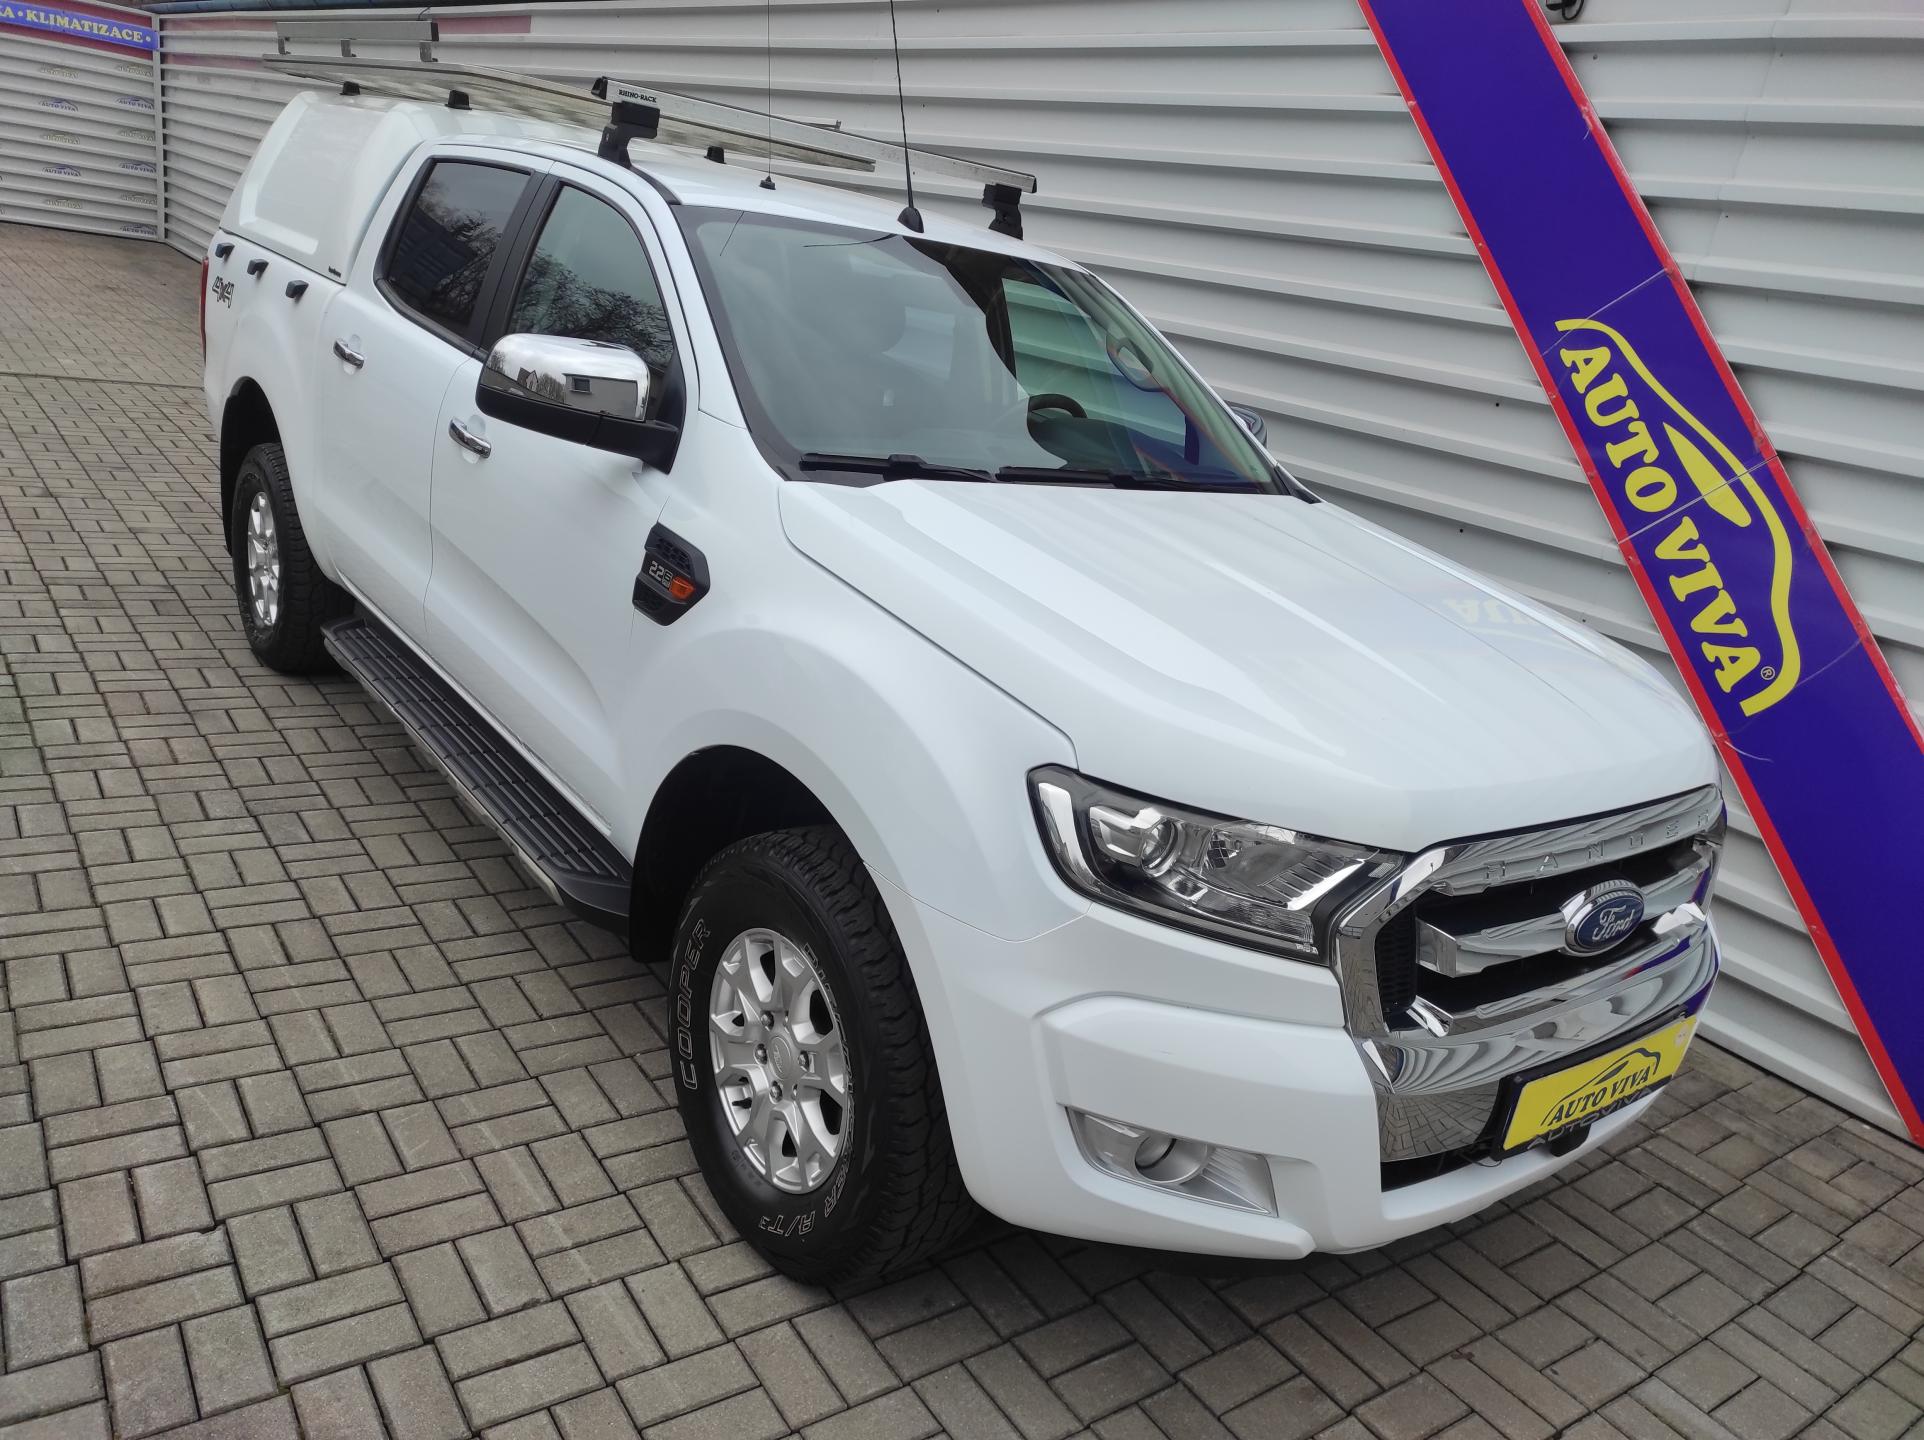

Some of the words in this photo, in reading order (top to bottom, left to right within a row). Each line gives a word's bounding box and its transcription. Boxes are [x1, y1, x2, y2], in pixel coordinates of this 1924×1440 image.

[26, 9, 144, 43] KLIMATIZACE
[618, 89, 657, 103] RHINO-RACK
[1559, 346, 1678, 512] AUTO
[1654, 516, 1761, 693] VIVA
[1485, 809, 1710, 880] RANGER
[1592, 905, 1636, 941] Ford
[678, 918, 711, 1090] COOPER
[1547, 1086, 1608, 1127] AUTO
[1610, 1065, 1651, 1099] VIVA
